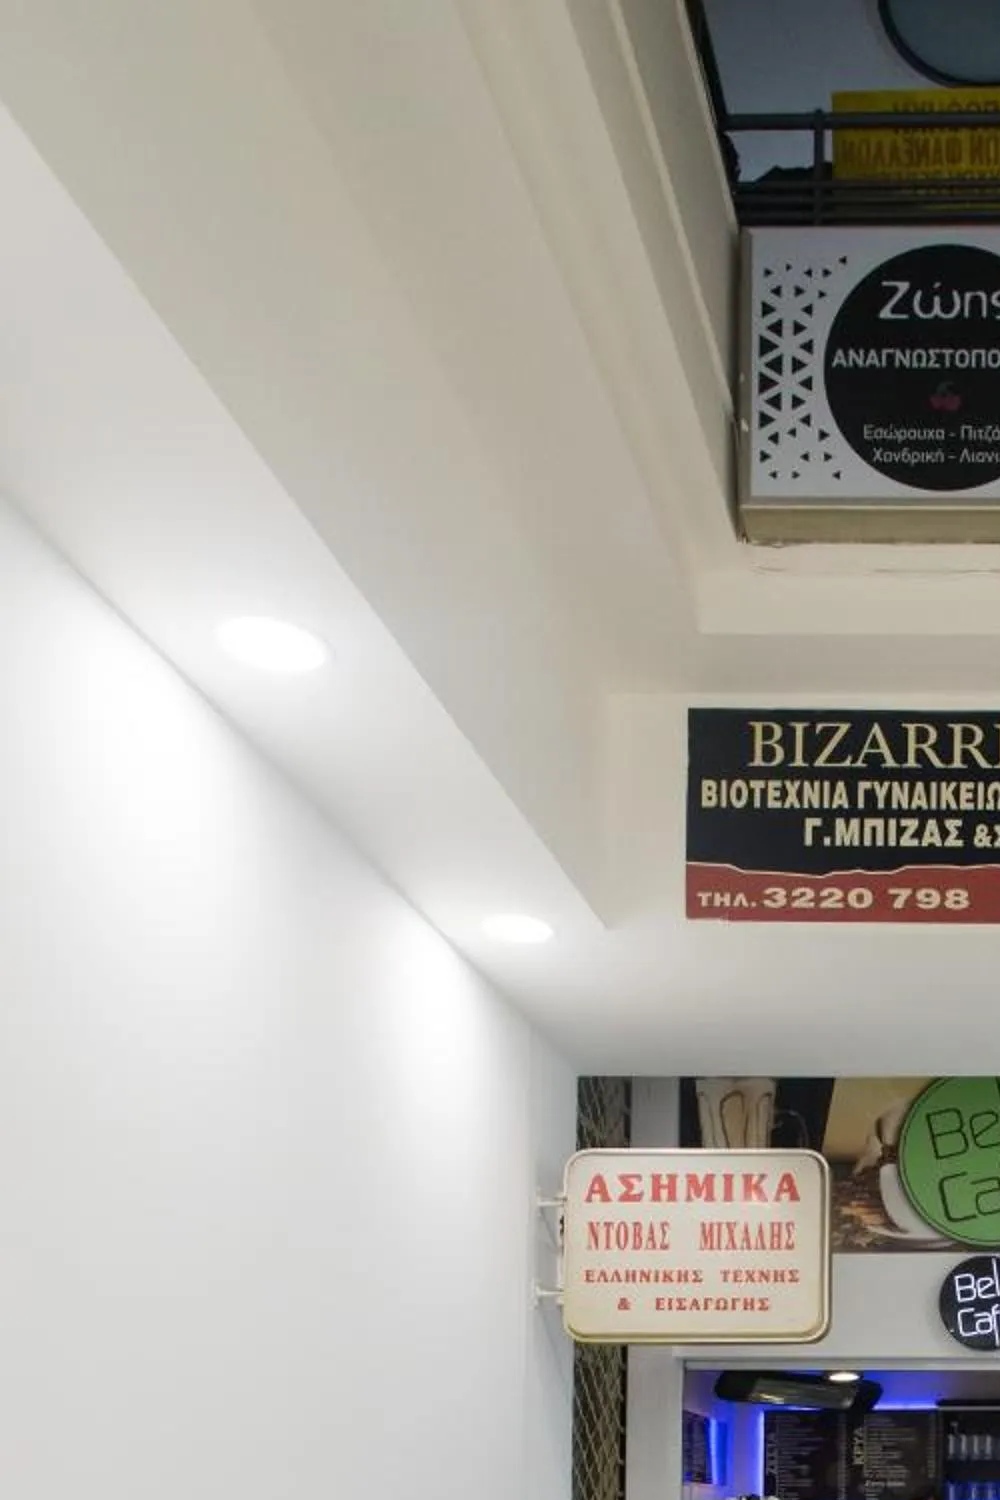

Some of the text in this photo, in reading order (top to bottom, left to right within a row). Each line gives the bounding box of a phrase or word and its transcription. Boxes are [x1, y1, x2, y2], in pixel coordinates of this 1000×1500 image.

[863, 423, 945, 444] Εσώρουχα
[872, 447, 945, 466] Χανδρική
[700, 779, 850, 810] ΒΙΟΤΕΧΝΙΑ
[697, 887, 971, 911] ΤΗΛ. 3220 798
[584, 1172, 802, 1204] ΑΣΗΜΙΚΑ
[586, 1220, 797, 1252] ΝΤΟΒΑΣ ΜΙΧΑΛΗΣ
[584, 1268, 801, 1284] ΕΛΛΗΝΙΚΗΣ ΤΕΧΝΗΣ
[954, 1257, 1000, 1303] Bel
[617, 1297, 771, 1312] & ΕΙΣΑΓΩΓΗΣ
